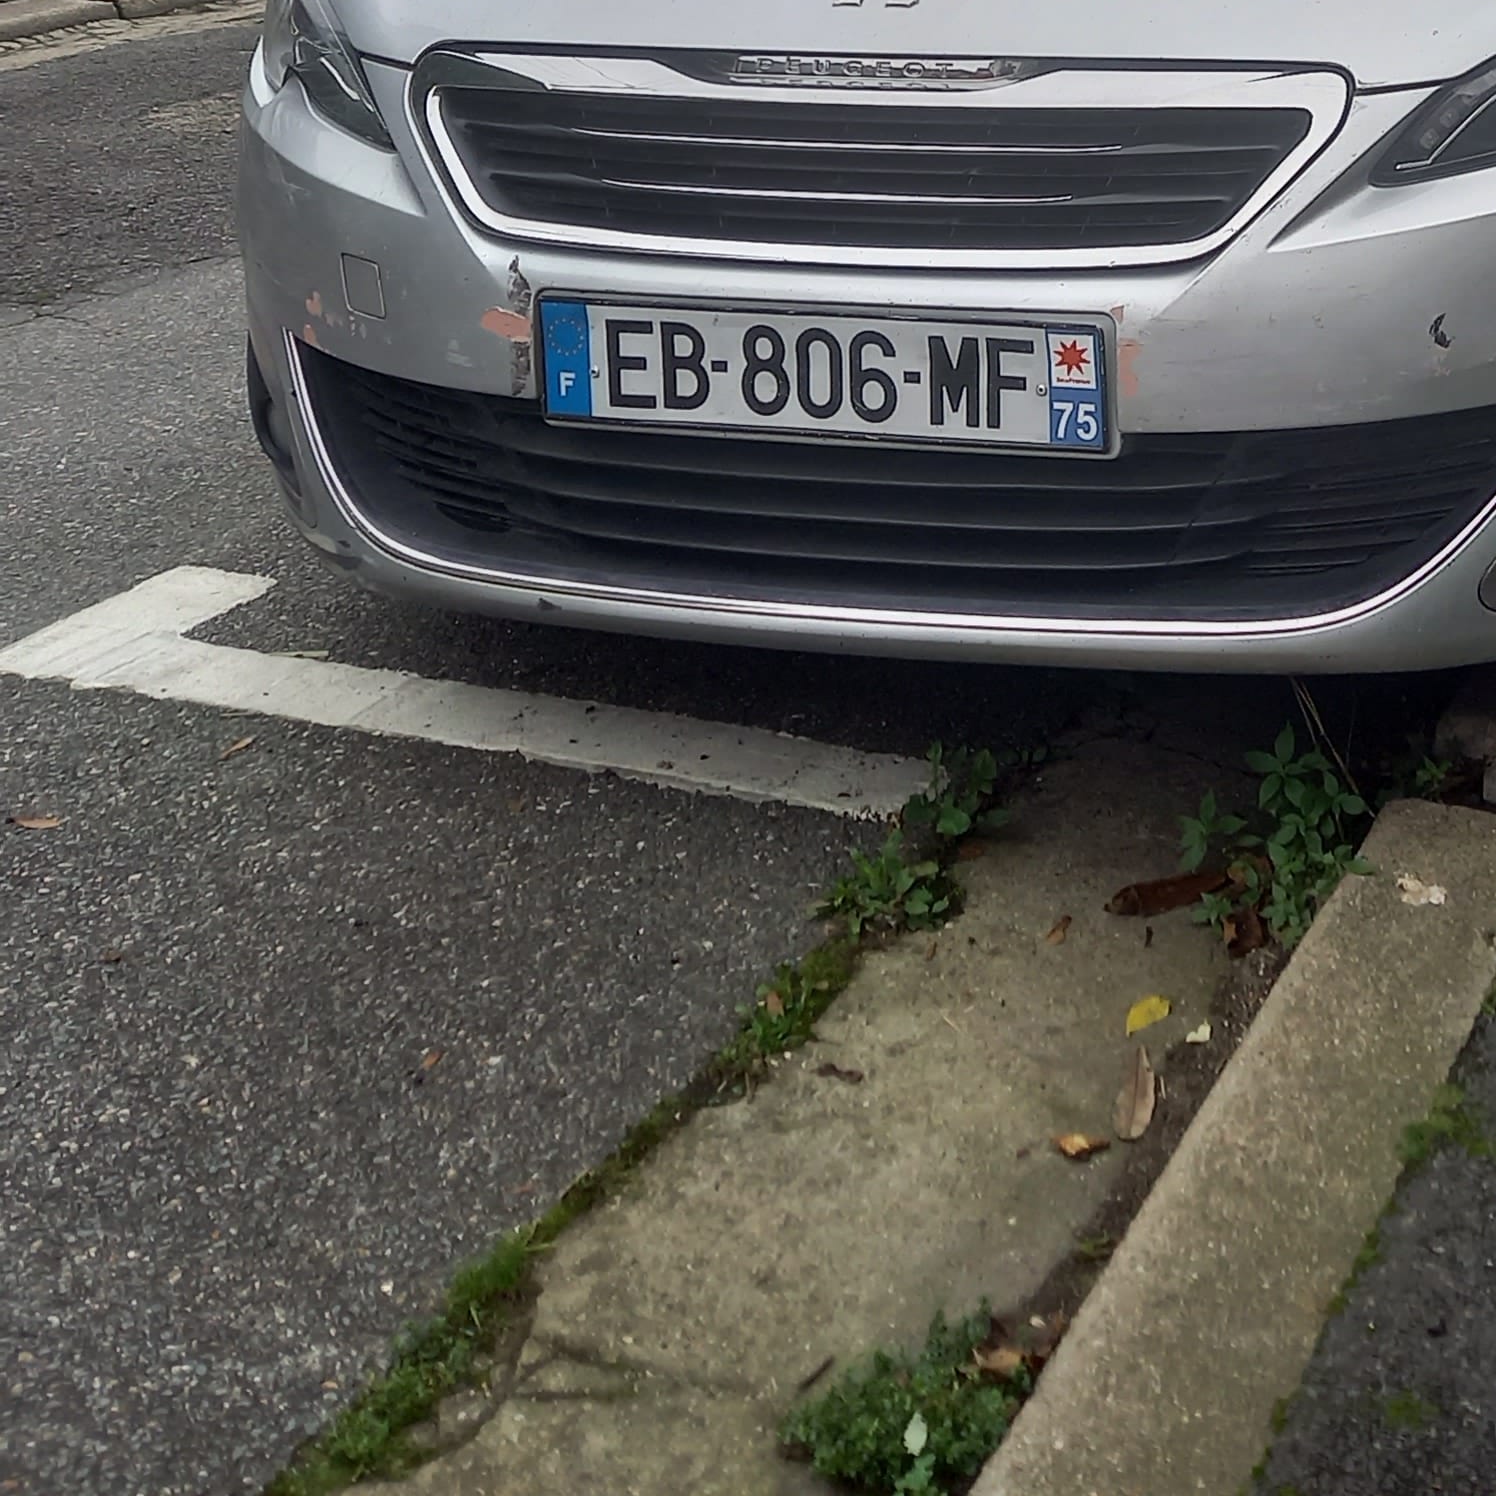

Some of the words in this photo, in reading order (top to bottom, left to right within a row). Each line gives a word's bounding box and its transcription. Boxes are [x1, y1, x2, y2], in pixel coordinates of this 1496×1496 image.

[755, 56, 953, 78] PEUGEOT
[559, 371, 576, 397] F
[605, 318, 1034, 429] EB-806-MF
[1052, 401, 1098, 441] 75
